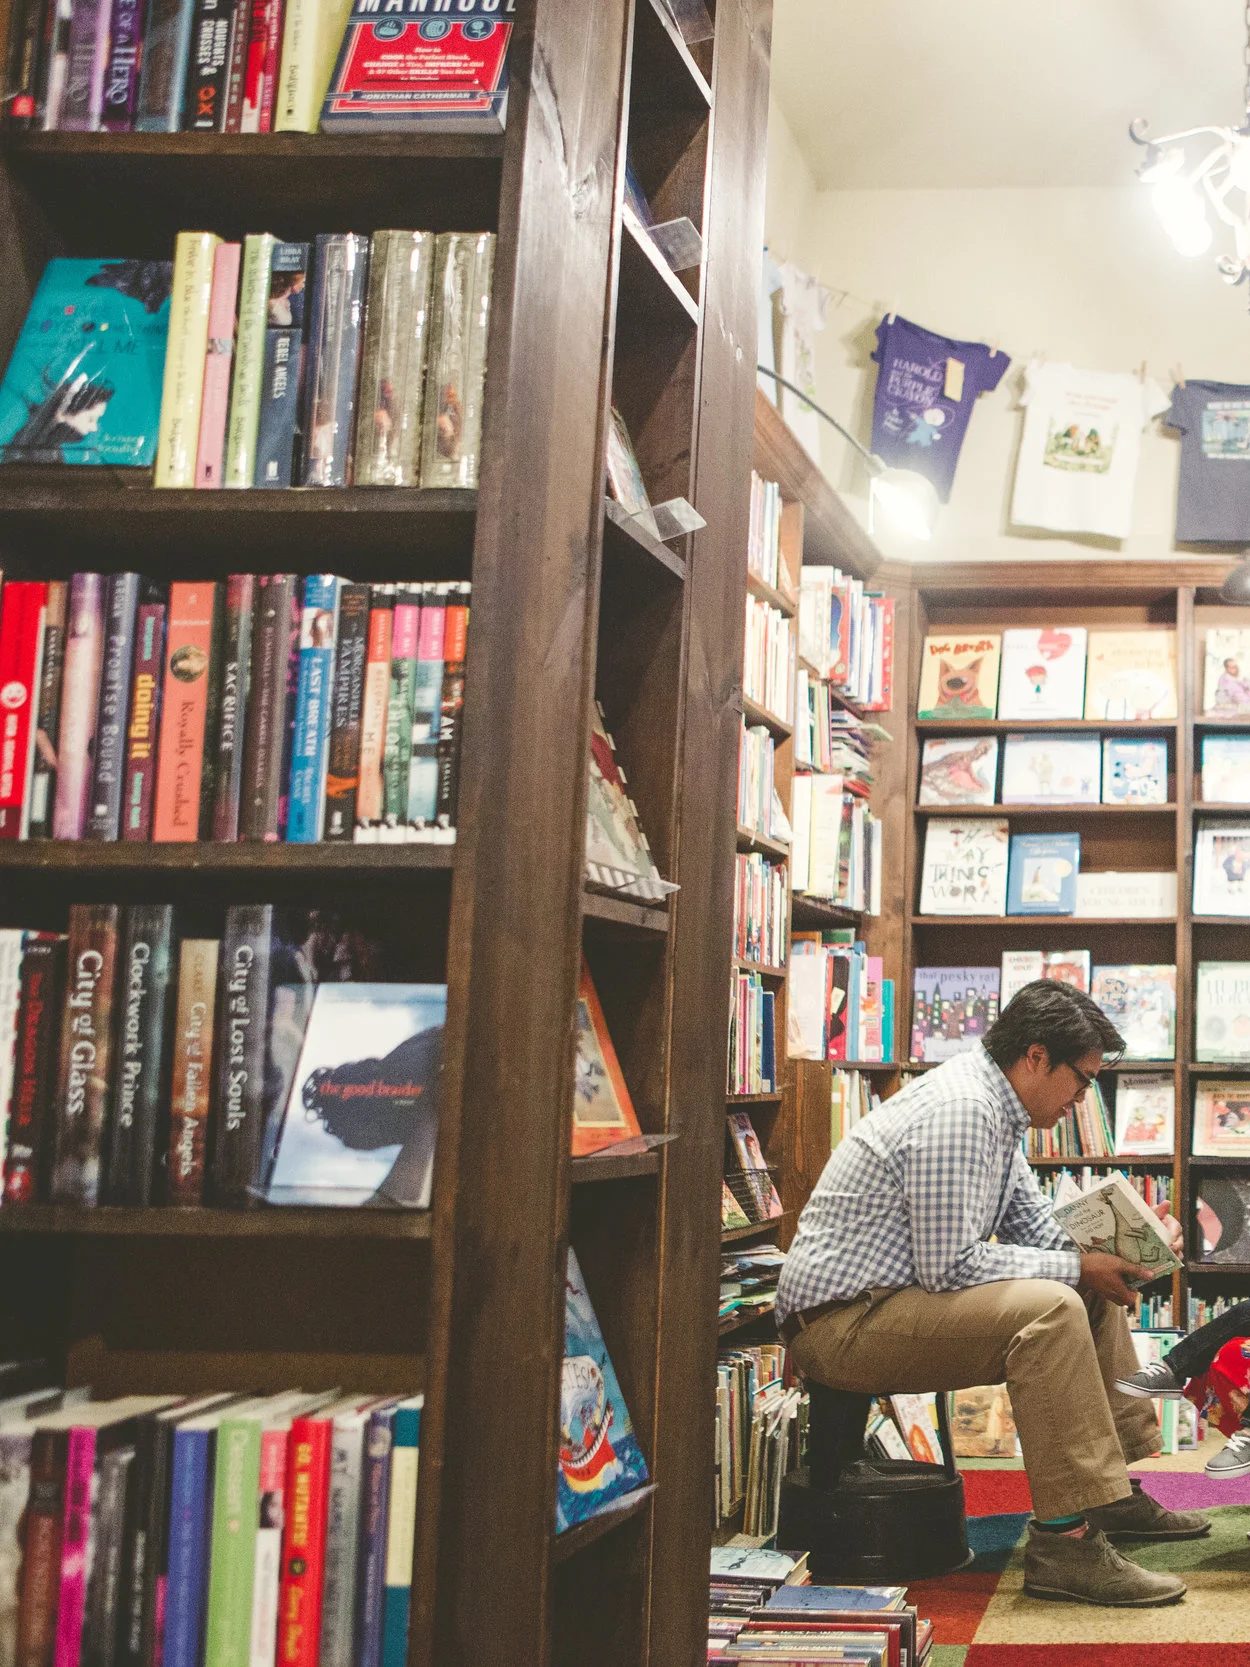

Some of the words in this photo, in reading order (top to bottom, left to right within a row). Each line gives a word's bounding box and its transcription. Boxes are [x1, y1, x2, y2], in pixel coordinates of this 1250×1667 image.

[198, 20, 215, 64] CROSSES
[212, 20, 229, 67] NOUGHTS
[106, 46, 136, 104] HERO
[275, 337, 291, 364] REBEL
[272, 367, 288, 399] ANGELS
[102, 635, 126, 714] Promise
[309, 656, 323, 694] LAST
[336, 638, 352, 728] VAMPIRES
[348, 636, 365, 730] MORGANVILLE
[130, 673, 156, 738] doing
[175, 700, 195, 759] Royally
[221, 661, 238, 751] SACRIFICE
[305, 698, 320, 758] BREATH
[385, 699, 401, 756] CHLOE
[440, 717, 455, 740] AM
[99, 724, 119, 783] Bound
[131, 743, 151, 759] it
[363, 731, 376, 755] ME
[172, 762, 191, 827] Crushed
[70, 950, 103, 1009] City
[229, 944, 254, 992] City
[940, 969, 976, 985] pesky
[124, 942, 150, 1054] Clockwork
[184, 1001, 207, 1038] City
[230, 996, 248, 1014] of
[72, 1014, 96, 1038] of
[229, 1017, 250, 1066] Lost
[66, 1040, 96, 1116] Glass
[119, 1061, 142, 1128] Prince
[183, 1061, 203, 1113] Fallen
[226, 1070, 248, 1131] Souls
[320, 1083, 341, 1096] the
[342, 1081, 376, 1100] good
[178, 1116, 200, 1176] Angels
[1064, 1199, 1089, 1215] DANNY
[1069, 1209, 1106, 1230] DINOSAUR
[226, 1428, 250, 1517] Dessen
